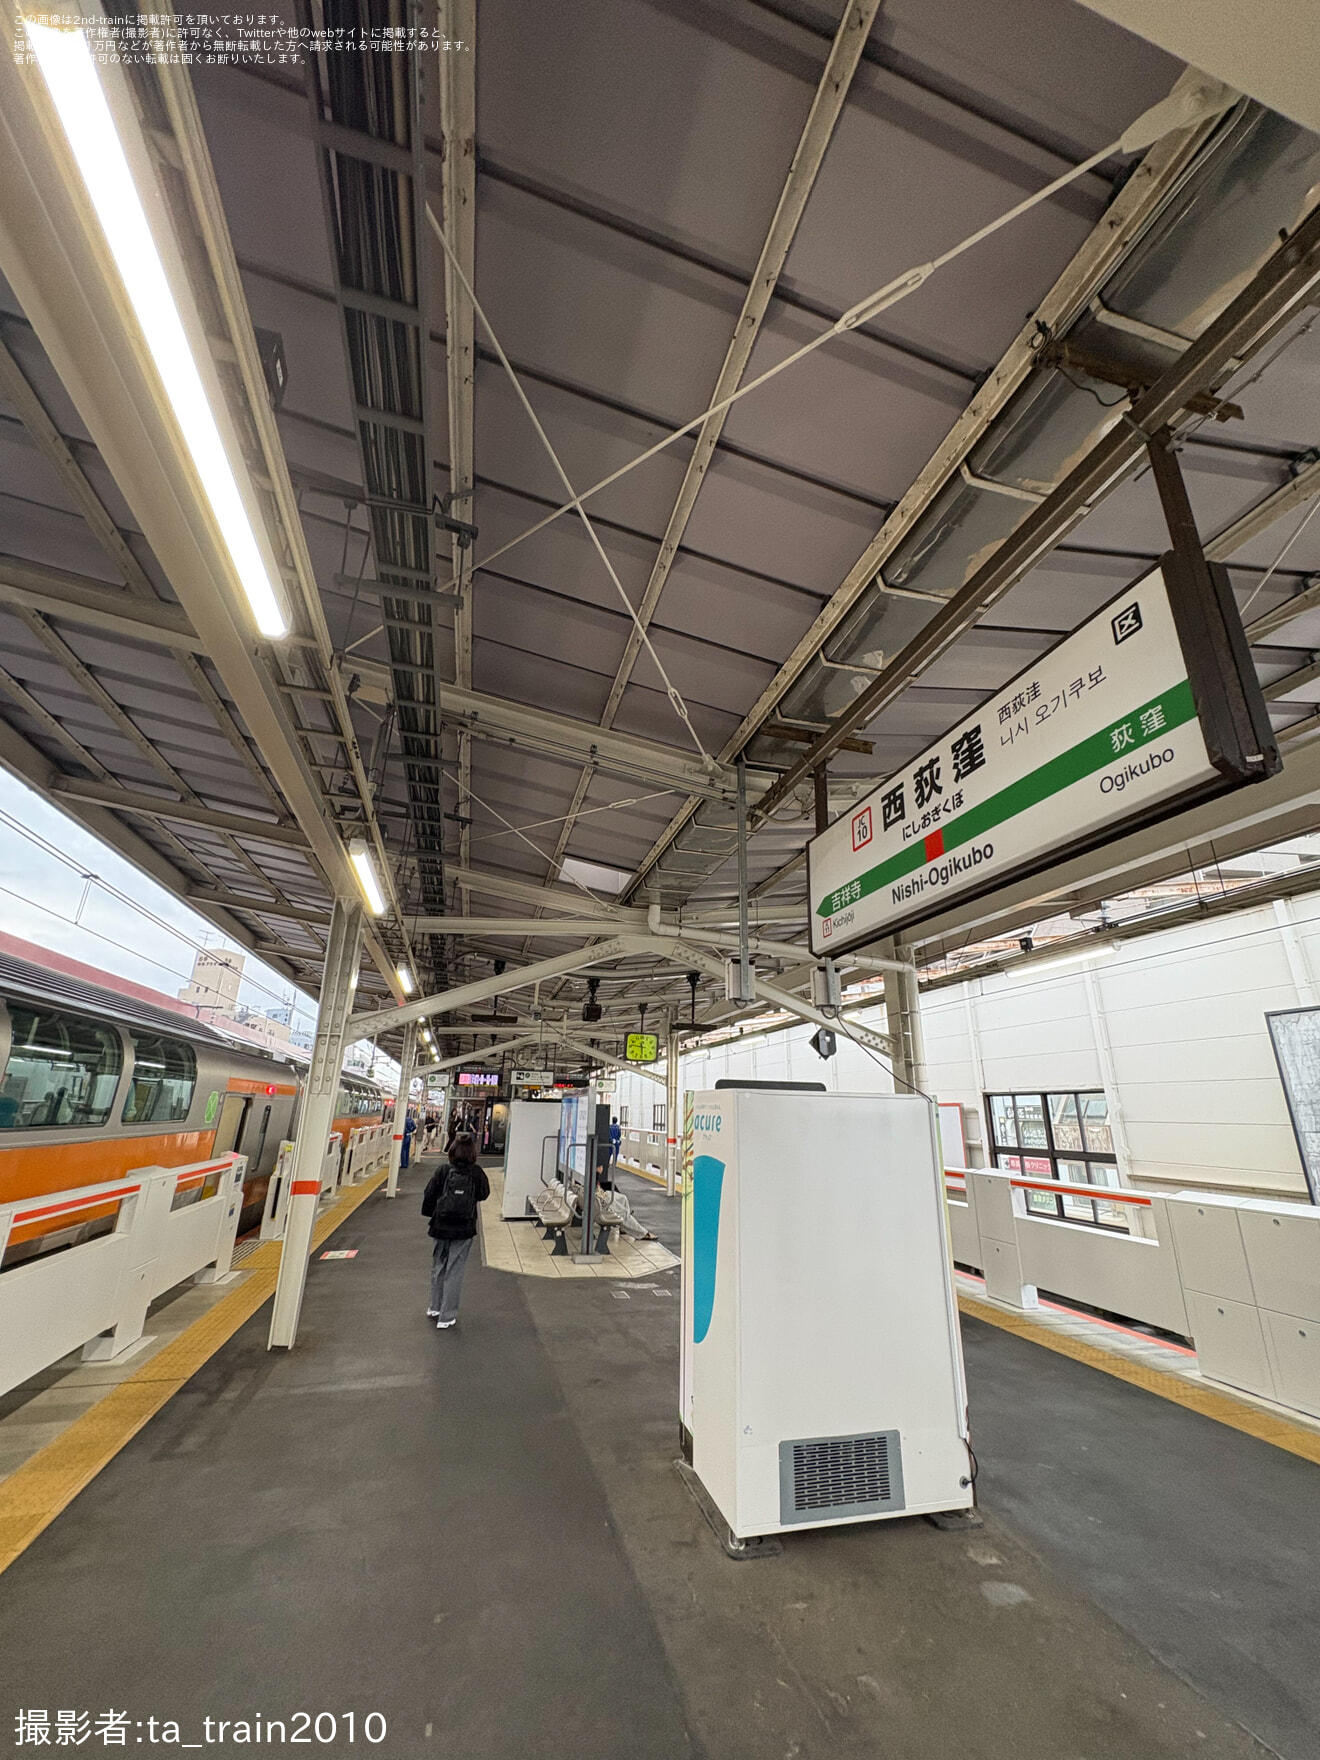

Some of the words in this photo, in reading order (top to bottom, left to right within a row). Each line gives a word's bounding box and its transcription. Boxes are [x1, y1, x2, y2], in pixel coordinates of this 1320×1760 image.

[997, 681, 1042, 725] 西荻洼
[1000, 717, 1029, 746] 니시
[1035, 665, 1107, 726] 오기쿠보
[1110, 704, 1167, 753] 荻窪
[881, 724, 986, 832] 西荻窪
[1100, 748, 1174, 794] Ogikubo
[857, 827, 868, 842] 10
[858, 815, 866, 829] JC
[902, 789, 964, 841] にしおぎくぼ
[831, 880, 862, 912] 吉祥寺
[891, 843, 994, 905] Nishi-Ogikubo
[694, 1114, 722, 1132] acure
